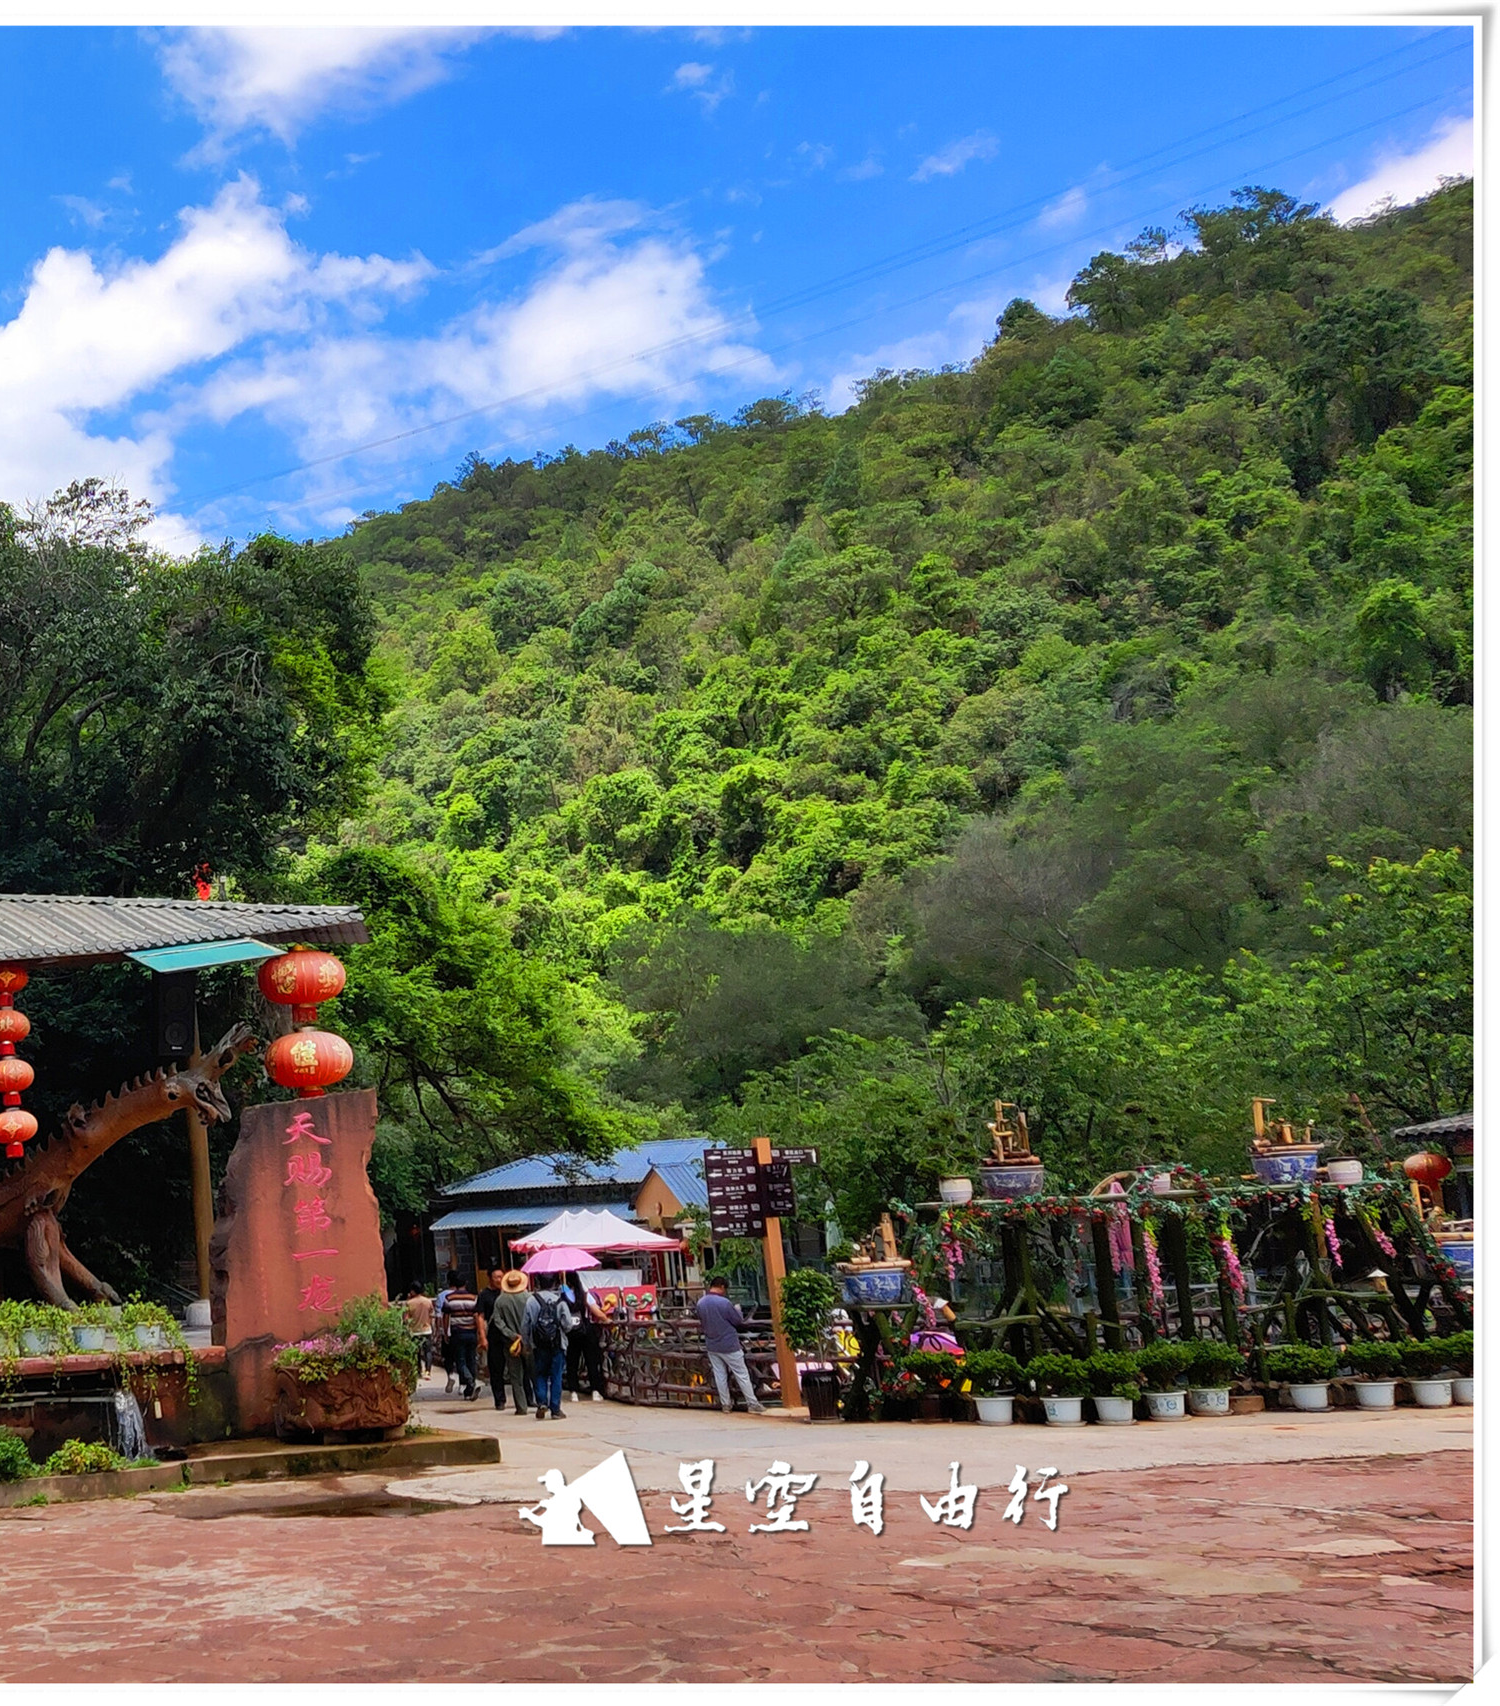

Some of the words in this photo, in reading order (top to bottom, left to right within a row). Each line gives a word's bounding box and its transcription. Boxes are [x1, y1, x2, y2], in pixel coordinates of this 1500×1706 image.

[283, 1112, 342, 1312] 天赐第一龙
